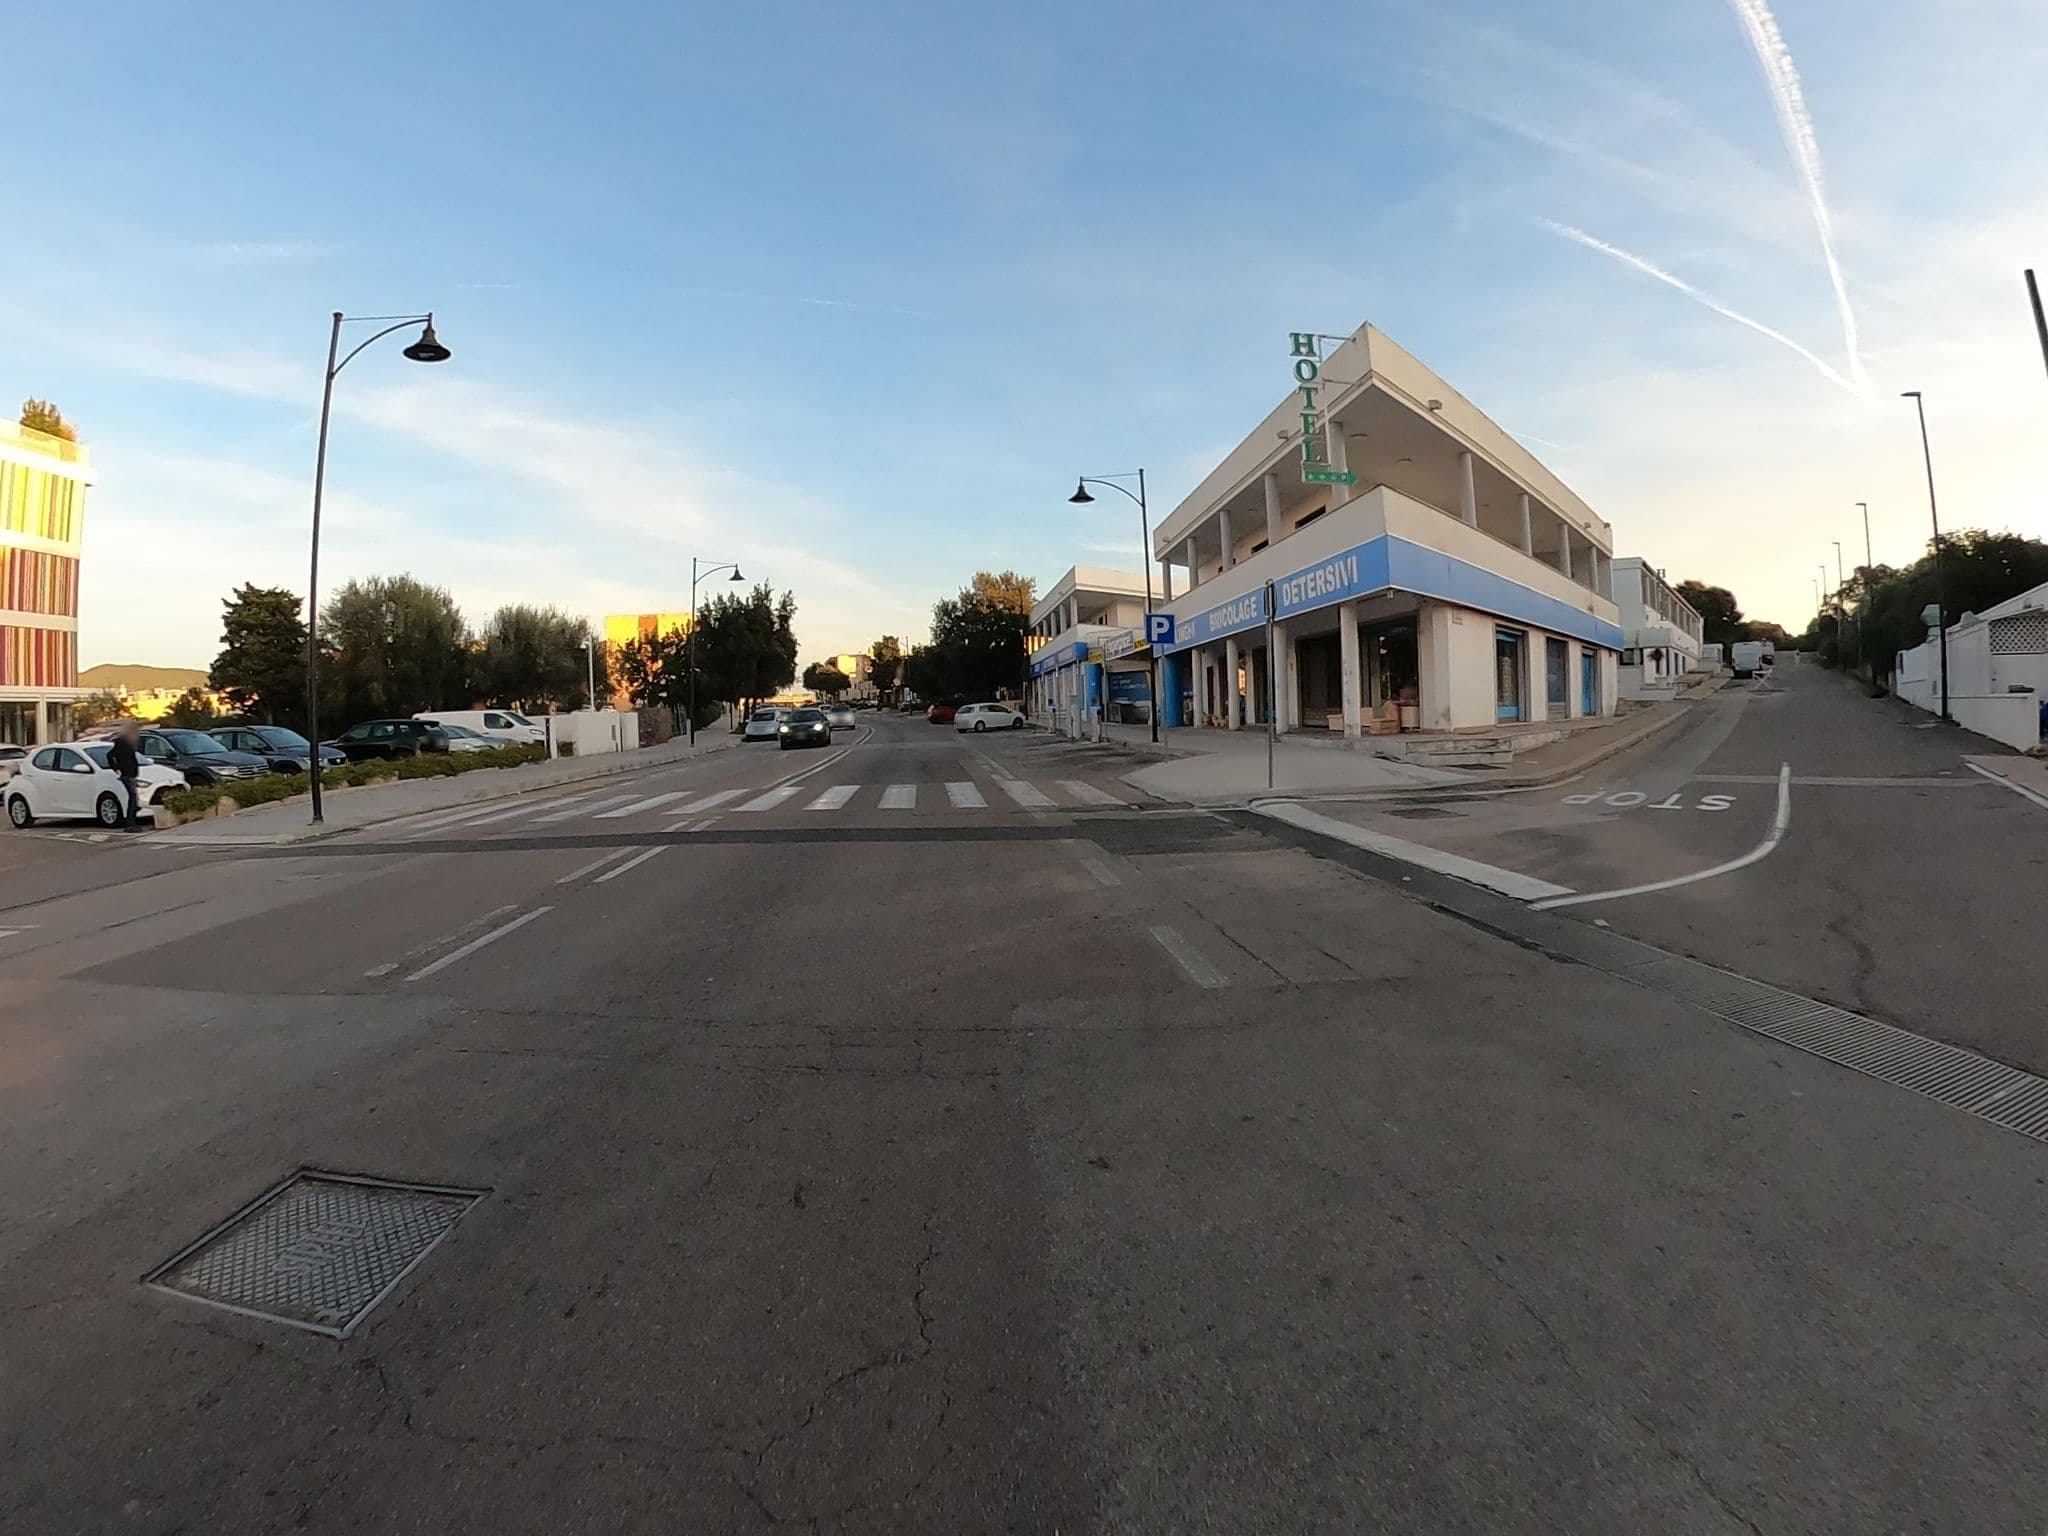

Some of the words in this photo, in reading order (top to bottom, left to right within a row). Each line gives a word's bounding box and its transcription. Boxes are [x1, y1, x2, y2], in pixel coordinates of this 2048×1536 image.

[1289, 332, 1321, 463] HOTEL
[1282, 555, 1358, 607] DETERSIVI
[1151, 616, 1170, 641] P
[1561, 790, 1737, 810] STOP
